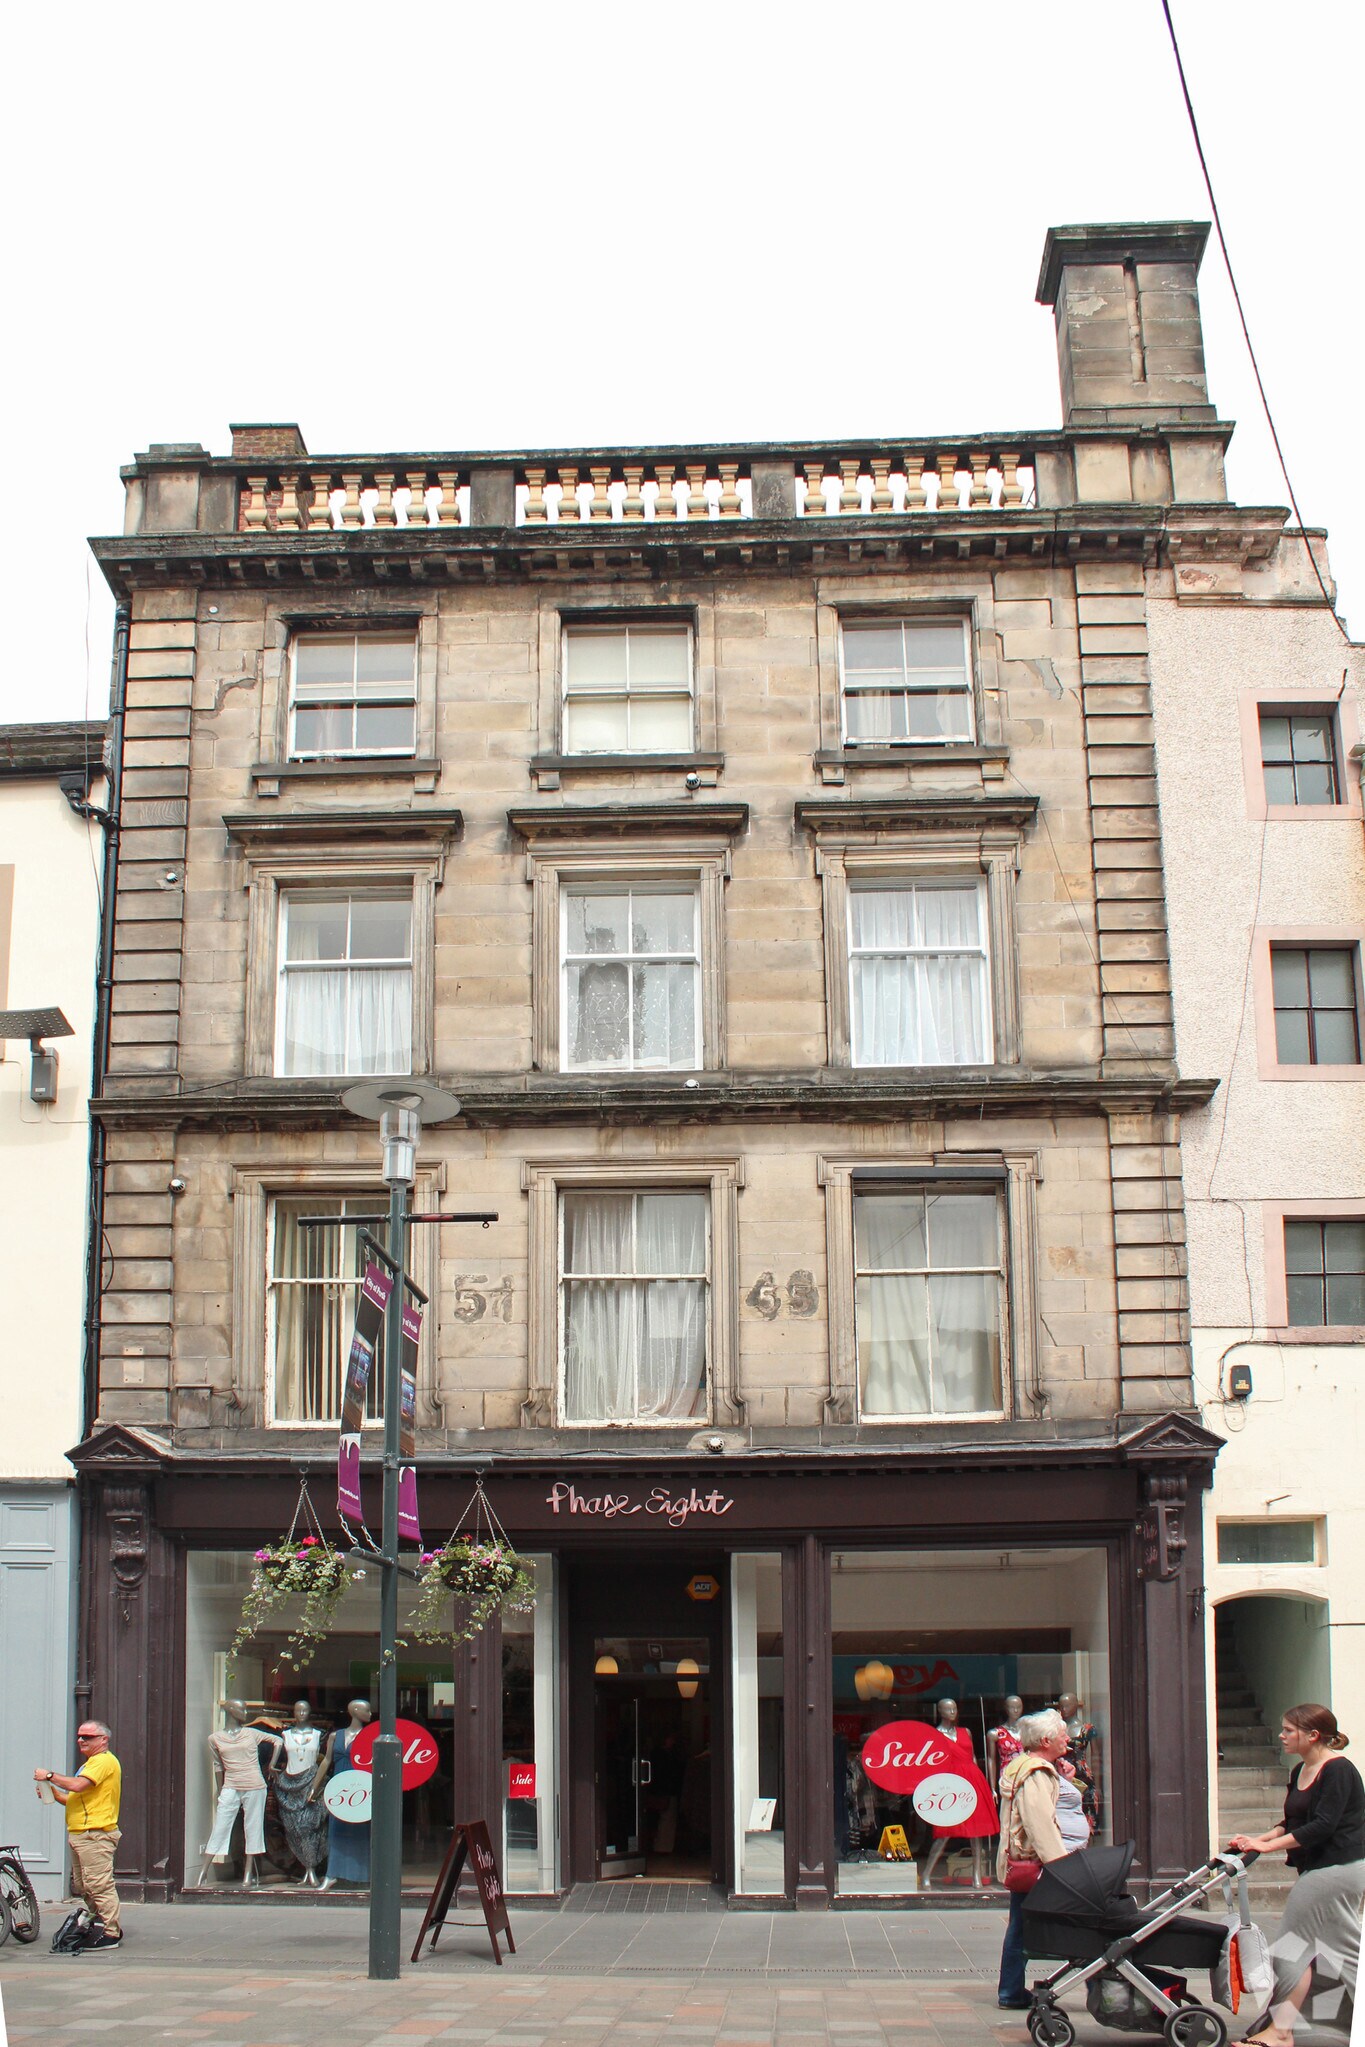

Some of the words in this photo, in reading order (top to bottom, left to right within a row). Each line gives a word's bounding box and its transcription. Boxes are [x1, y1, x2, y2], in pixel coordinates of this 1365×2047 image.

[546, 1482, 642, 1518] Phase
[645, 1487, 734, 1527] Eight
[694, 1583, 711, 1591] ADT
[353, 1738, 436, 1766] le
[864, 1740, 949, 1769] Sale
[511, 1773, 533, 1786] Sale
[327, 1788, 372, 1807] 50
[917, 1791, 974, 1812] 50%
